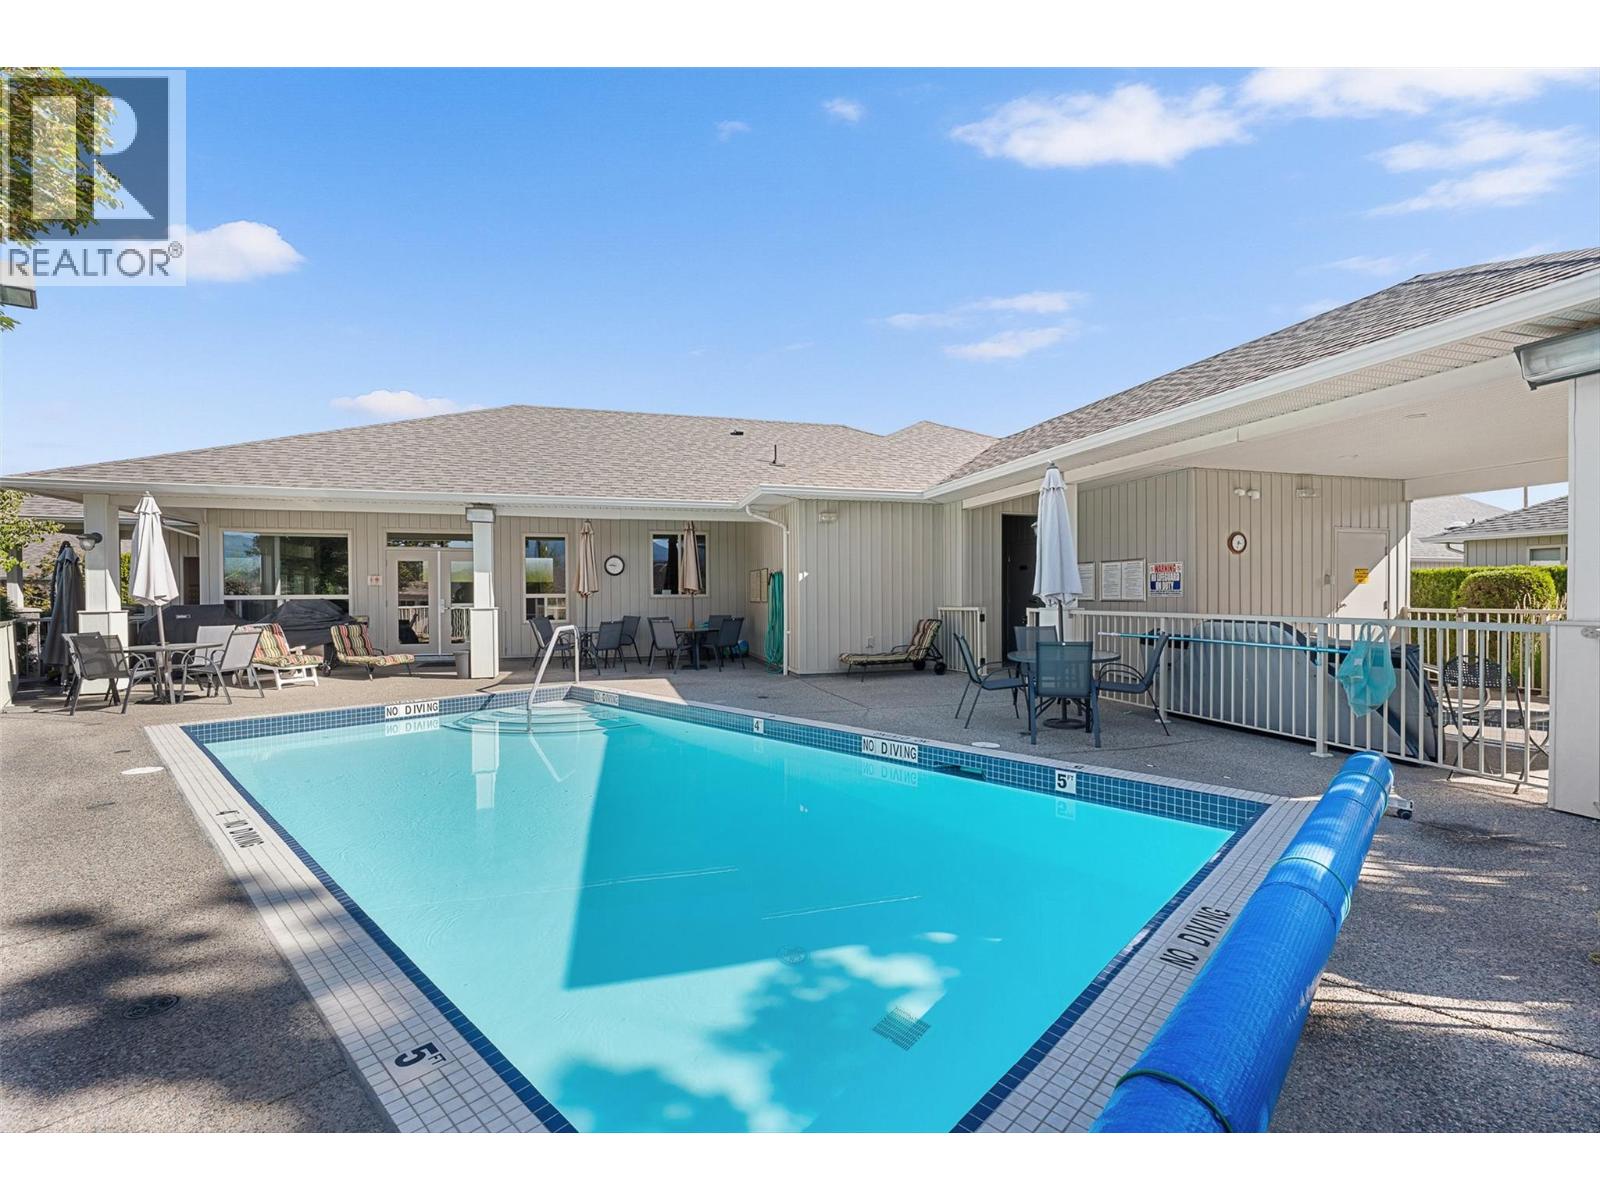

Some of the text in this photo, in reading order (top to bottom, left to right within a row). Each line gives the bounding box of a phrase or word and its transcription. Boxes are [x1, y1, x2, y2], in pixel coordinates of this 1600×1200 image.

[1154, 563, 1177, 573] WARNING
[386, 702, 439, 717] NO DIVING
[754, 720, 760, 731] 4
[863, 739, 917, 759] NO DIVING
[1160, 906, 1231, 970] NO DIVING
